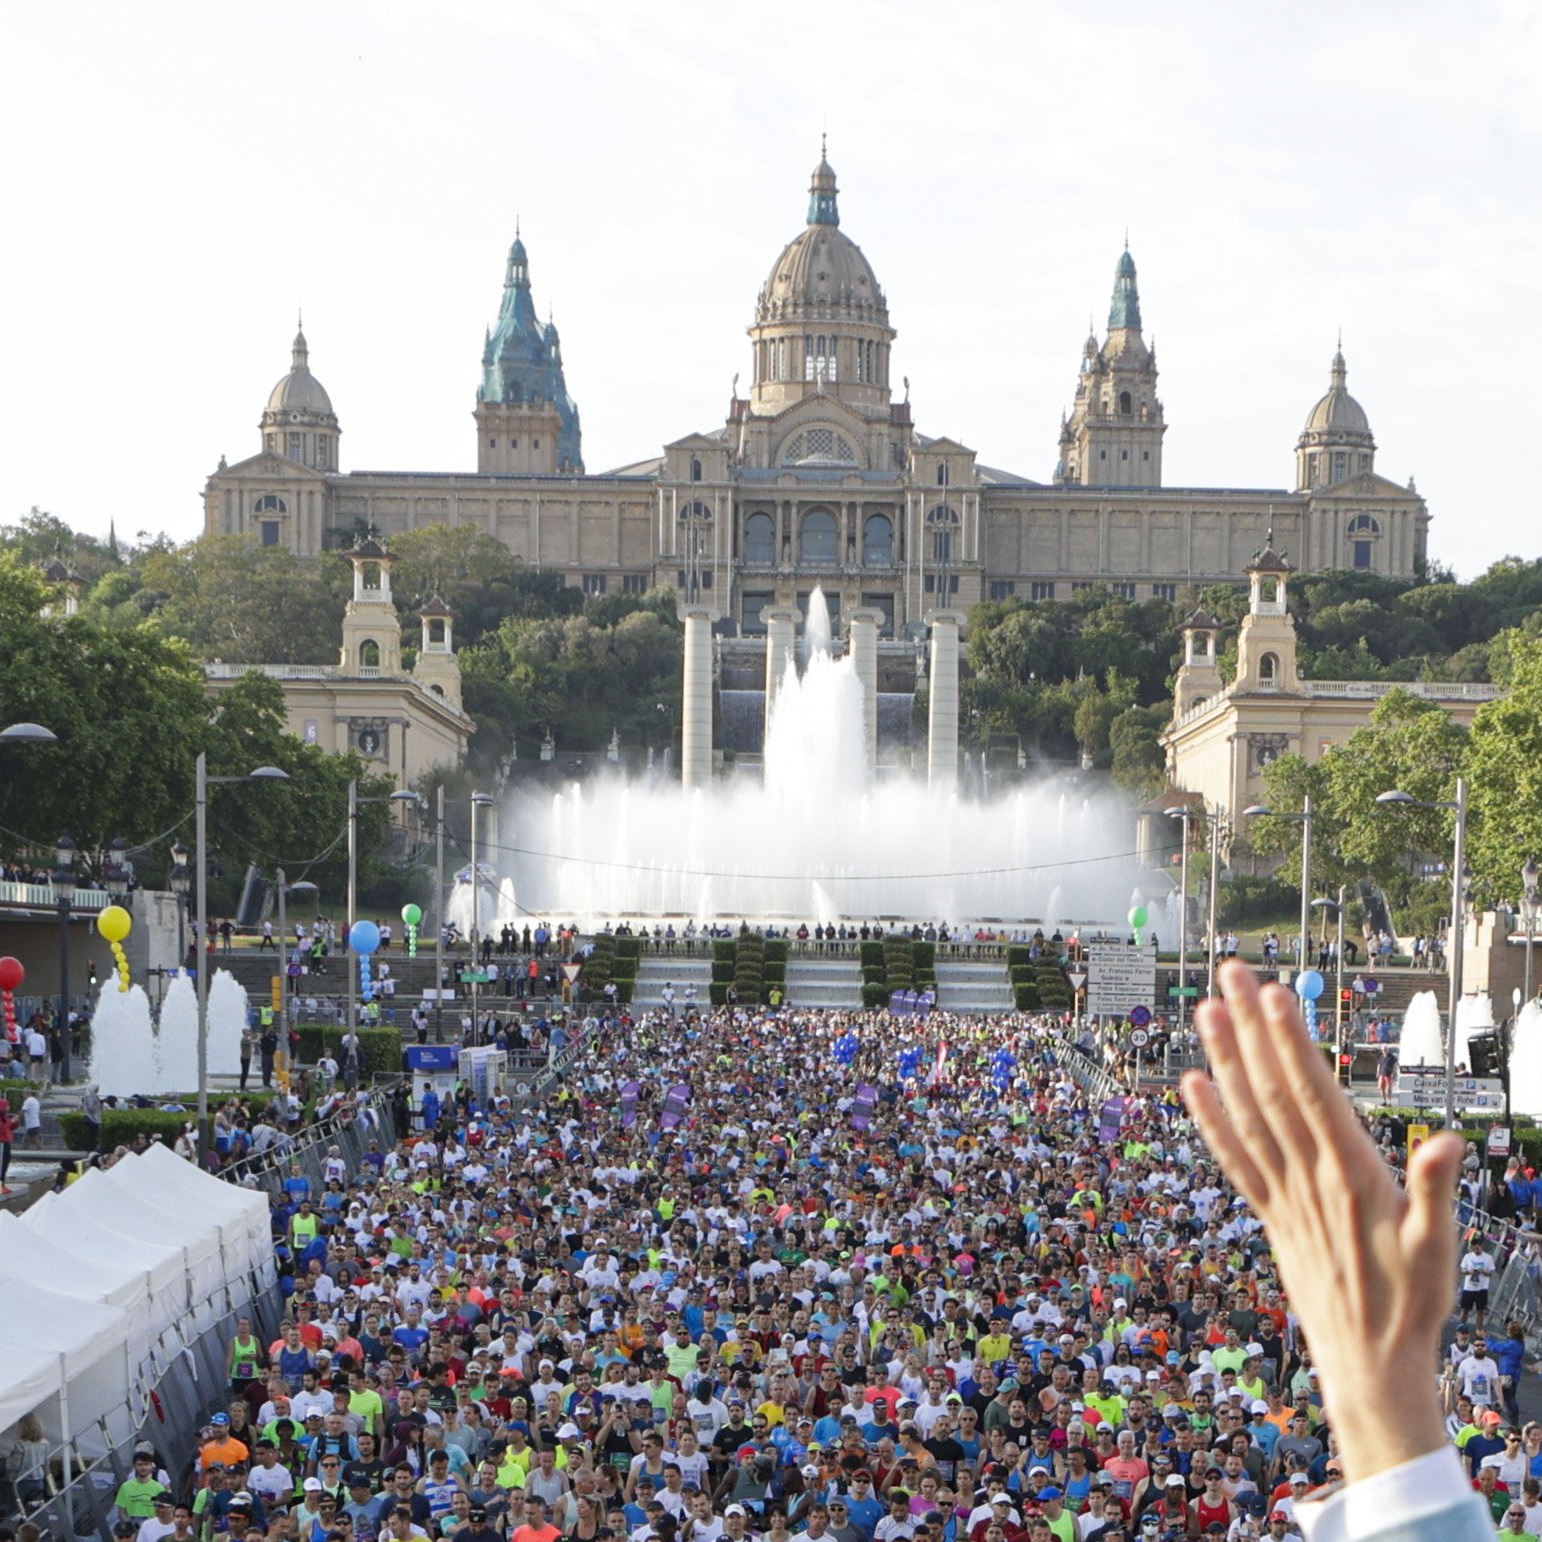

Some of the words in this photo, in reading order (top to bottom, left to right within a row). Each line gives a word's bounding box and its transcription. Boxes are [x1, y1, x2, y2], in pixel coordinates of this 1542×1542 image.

[1133, 1033, 1146, 1042] 30
[1413, 1079, 1464, 1088] CaixaFoum
[1413, 1095, 1430, 1103] Mies
[1457, 1095, 1475, 1104] Rohe
